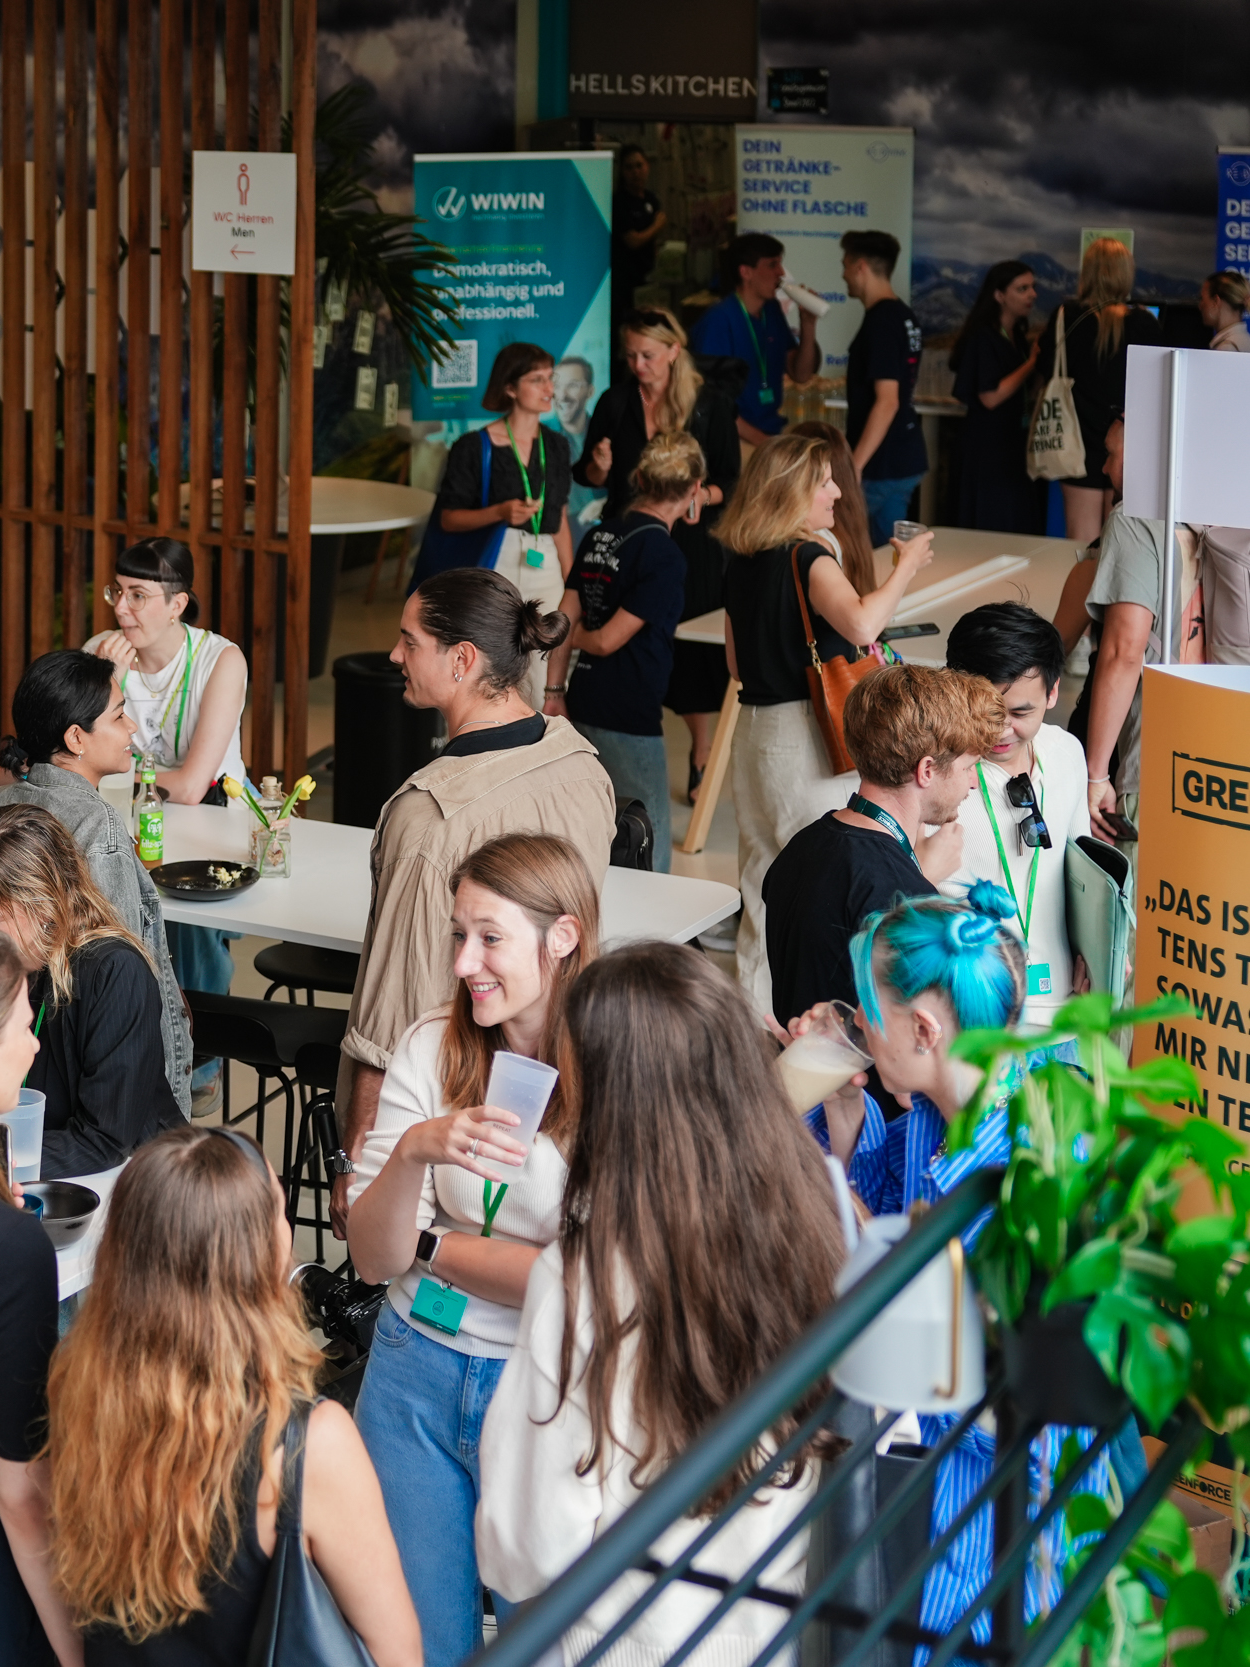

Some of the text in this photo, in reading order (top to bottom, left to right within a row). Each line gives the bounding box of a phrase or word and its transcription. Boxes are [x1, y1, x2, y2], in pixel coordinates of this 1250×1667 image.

[743, 138, 782, 154] DEIN
[743, 155, 841, 176] GETRÄNKE-
[743, 178, 812, 195] SERVICE
[471, 193, 545, 211] WIWIN
[742, 199, 868, 217] OHNE FLASCHE
[1226, 198, 1250, 217] DE
[213, 211, 275, 225] WC Herren
[231, 226, 256, 238] Men
[1225, 221, 1250, 240] GE
[532, 280, 565, 297] und
[1183, 769, 1249, 814] GRE
[1222, 900, 1250, 936] IS
[1157, 926, 1250, 986] TENS T
[1156, 974, 1250, 1036] SOWA
[1154, 1021, 1208, 1071] MIR
[1218, 1093, 1250, 1134] TE
[1174, 1473, 1231, 1501] ENFORCE
